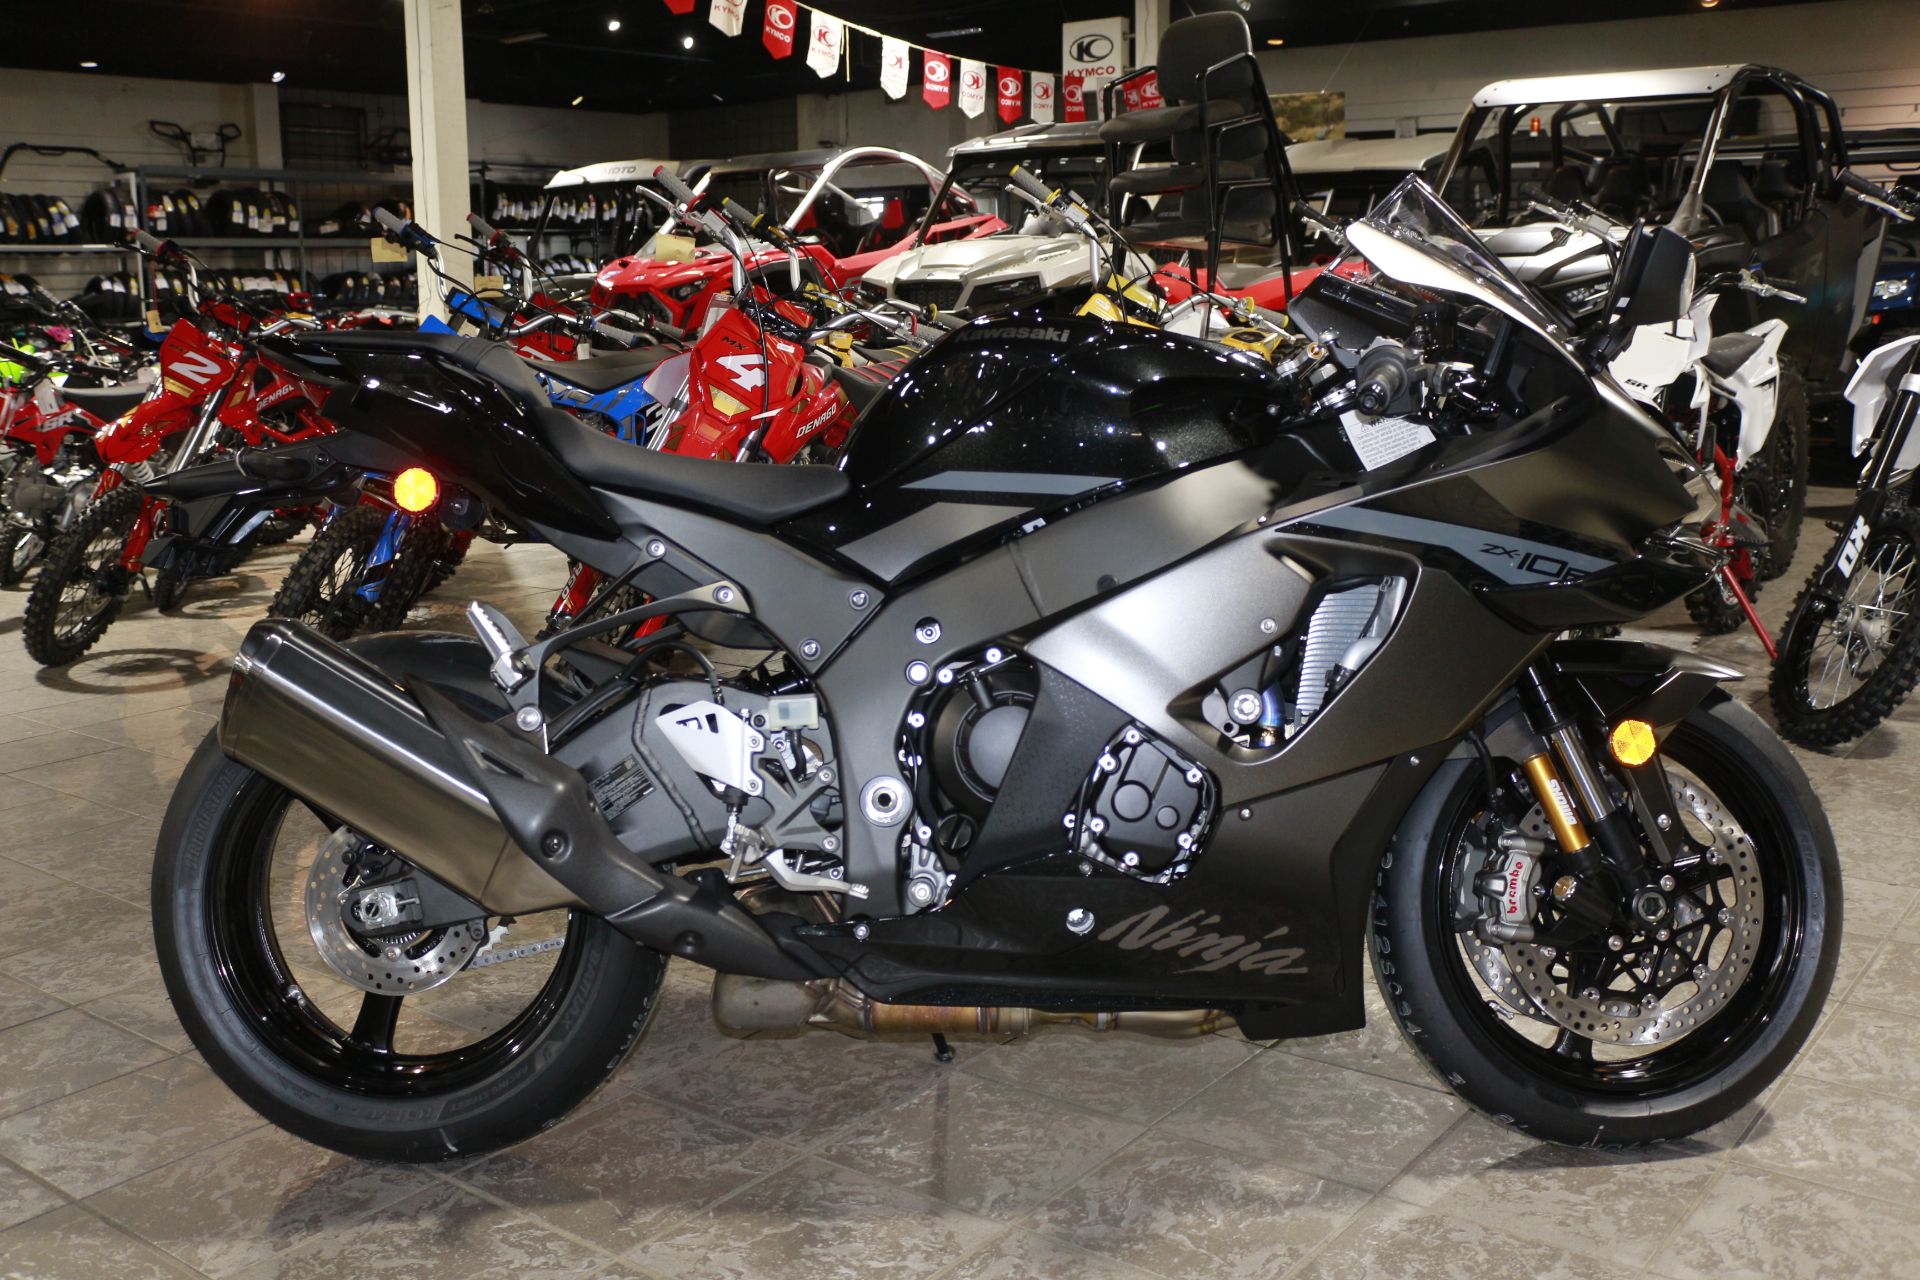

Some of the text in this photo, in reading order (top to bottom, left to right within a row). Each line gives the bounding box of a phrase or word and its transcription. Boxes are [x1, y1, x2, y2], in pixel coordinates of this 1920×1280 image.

[713, 4, 741, 22] KYMCO
[765, 26, 791, 43] KYMCO
[811, 47, 836, 61] KYMCO
[1067, 65, 1116, 78] KYMCO
[721, 335, 747, 351] MX
[955, 326, 1071, 344] Kawasaki
[167, 350, 223, 385] 2
[715, 353, 774, 393] 4
[1624, 378, 1649, 391] SR
[796, 402, 838, 439] DENAGO
[1507, 861, 1524, 915] brembo
[1097, 904, 1310, 976] Ninja
